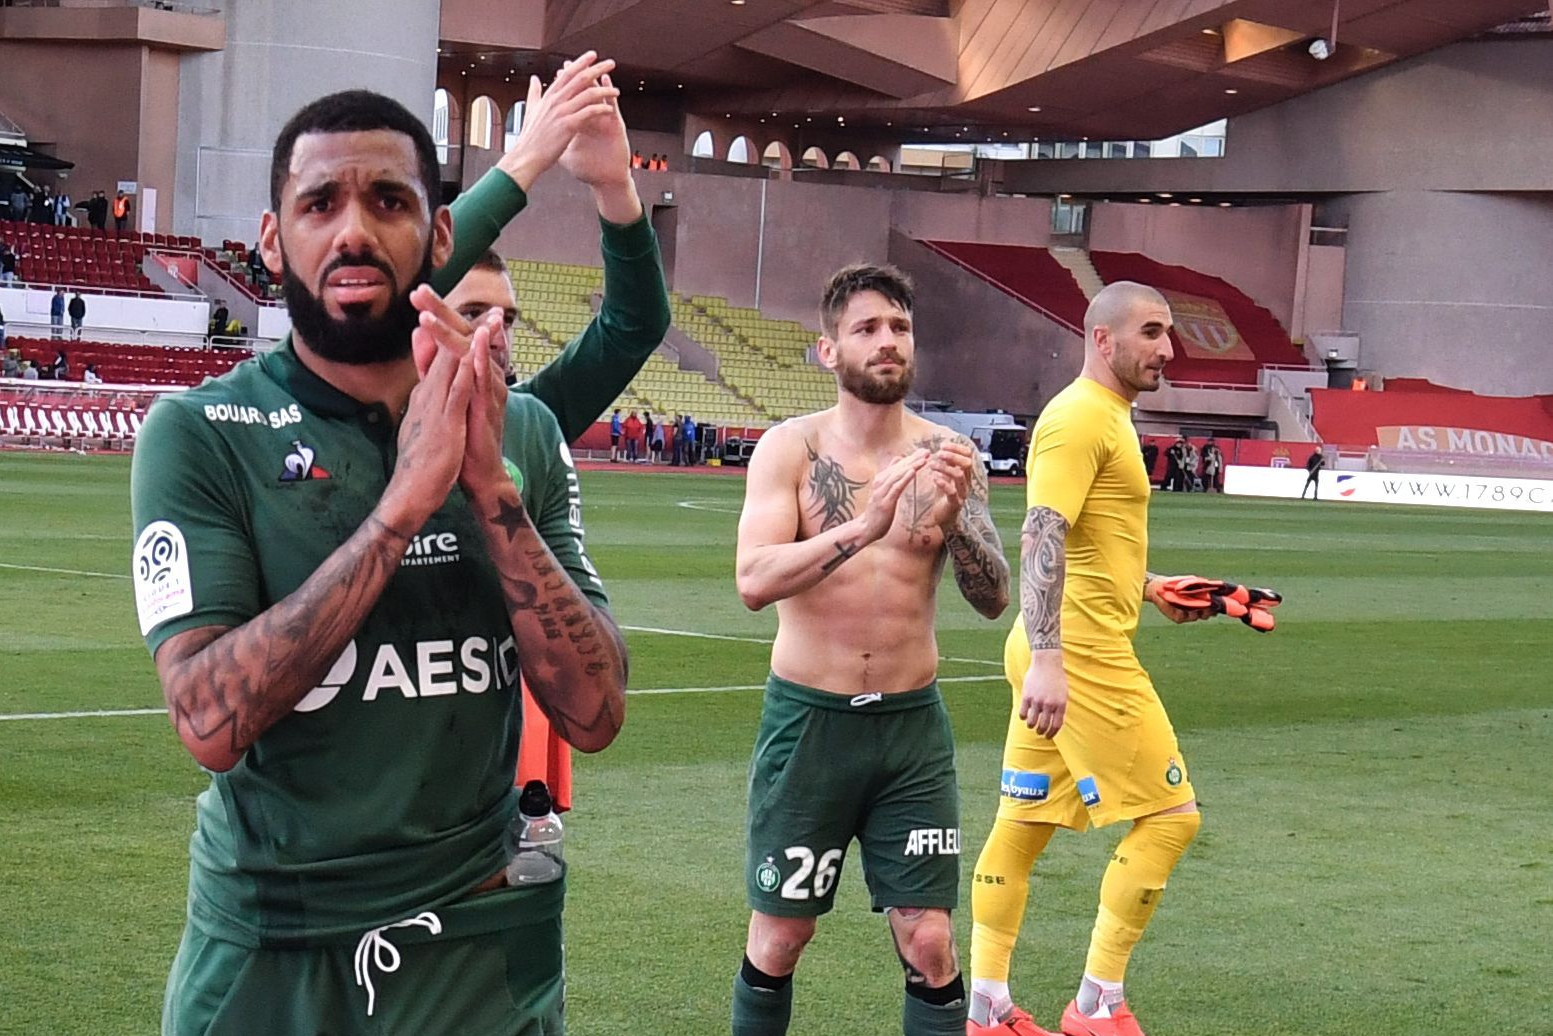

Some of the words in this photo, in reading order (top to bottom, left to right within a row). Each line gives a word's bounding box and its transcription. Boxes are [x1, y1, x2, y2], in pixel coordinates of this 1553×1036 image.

[268, 404, 302, 430] SAS
[1397, 426, 1439, 452] AS
[1382, 480, 1553, 504] WWW.1789C
[404, 532, 459, 556] ire
[400, 553, 460, 567] EPARTEMENT
[781, 846, 843, 900] 26
[975, 873, 1007, 885] SSE
